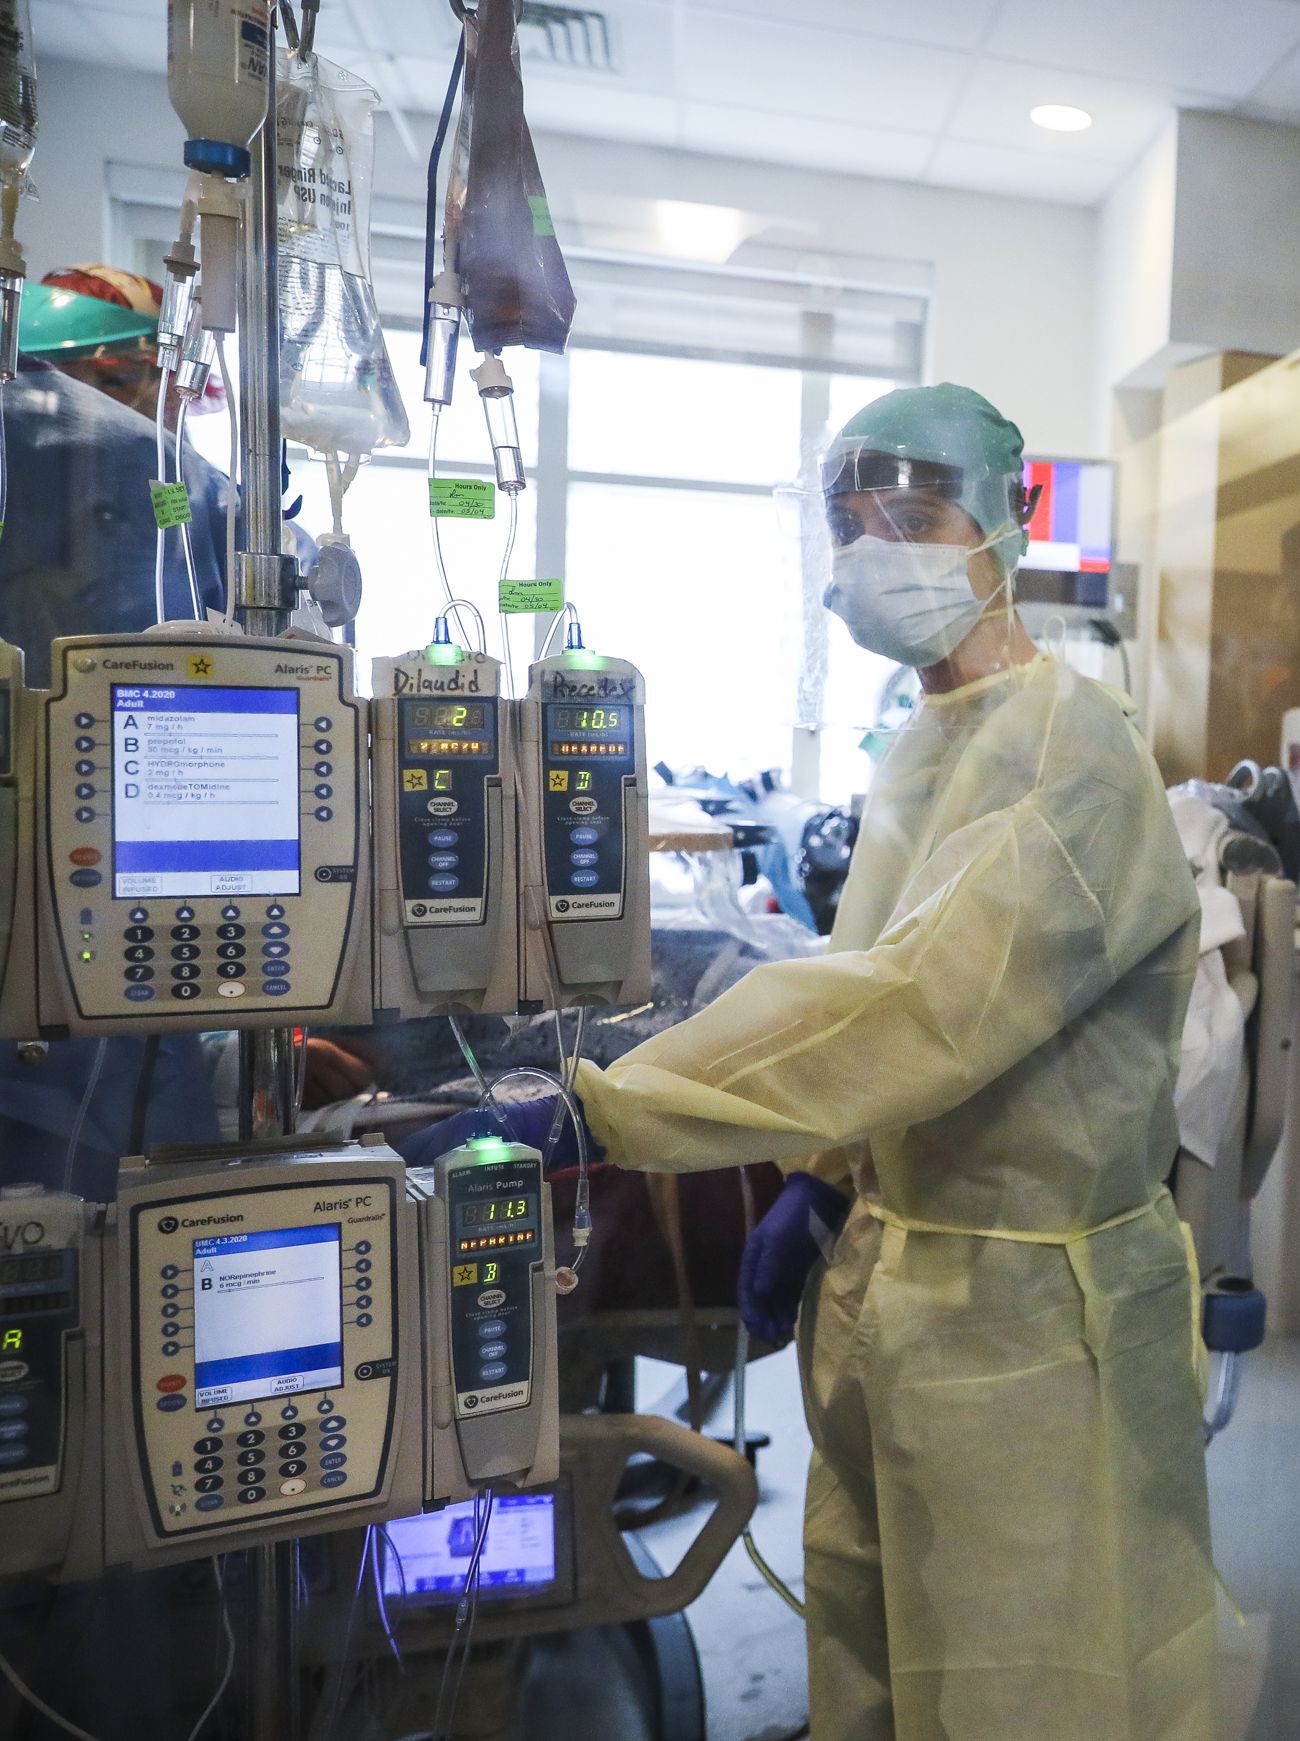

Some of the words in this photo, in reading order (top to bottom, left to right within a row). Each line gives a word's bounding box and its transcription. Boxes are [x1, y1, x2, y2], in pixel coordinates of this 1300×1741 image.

[102, 660, 174, 671] CareFusion
[316, 666, 332, 674] PC
[392, 668, 480, 697] Dilaudid
[117, 690, 141, 699] BMC
[117, 699, 144, 708] Adult
[123, 715, 138, 730] A
[452, 707, 467, 726] 2
[582, 710, 618, 728] 10.5
[124, 738, 139, 752] B
[124, 760, 139, 775] C
[125, 783, 140, 798] D
[429, 906, 476, 914] CareFusion
[135, 929, 142, 939] 1
[182, 928, 190, 938] 2
[227, 927, 235, 937] 3
[134, 948, 143, 959] 4
[182, 948, 190, 957] 5
[227, 946, 235, 956] 6
[135, 968, 143, 978] 7
[182, 967, 190, 977] 8
[227, 965, 235, 975] 9
[181, 986, 190, 996] 0
[468, 1184, 493, 1192] Alaris
[496, 1180, 524, 1189] Pump
[181, 1214, 244, 1228] CareFusion
[355, 1196, 372, 1207] PC
[488, 1201, 525, 1219] 11.3
[195, 1246, 217, 1255] Adult
[201, 1260, 214, 1272] A
[201, 1277, 213, 1290] B
[2, 1329, 22, 1350] A
[274, 1384, 300, 1392] ADJUST
[480, 1390, 524, 1404] CareFusion
[206, 1441, 211, 1450] 1
[248, 1435, 255, 1444] 2
[289, 1427, 296, 1436] 3
[205, 1460, 212, 1469] 4
[248, 1453, 255, 1463] 5
[289, 1446, 296, 1455] 6
[205, 1480, 212, 1489] 7
[248, 1472, 255, 1482] 8
[289, 1464, 297, 1474] 9
[325, 1457, 342, 1465] ENTER
[248, 1490, 256, 1500] 0
